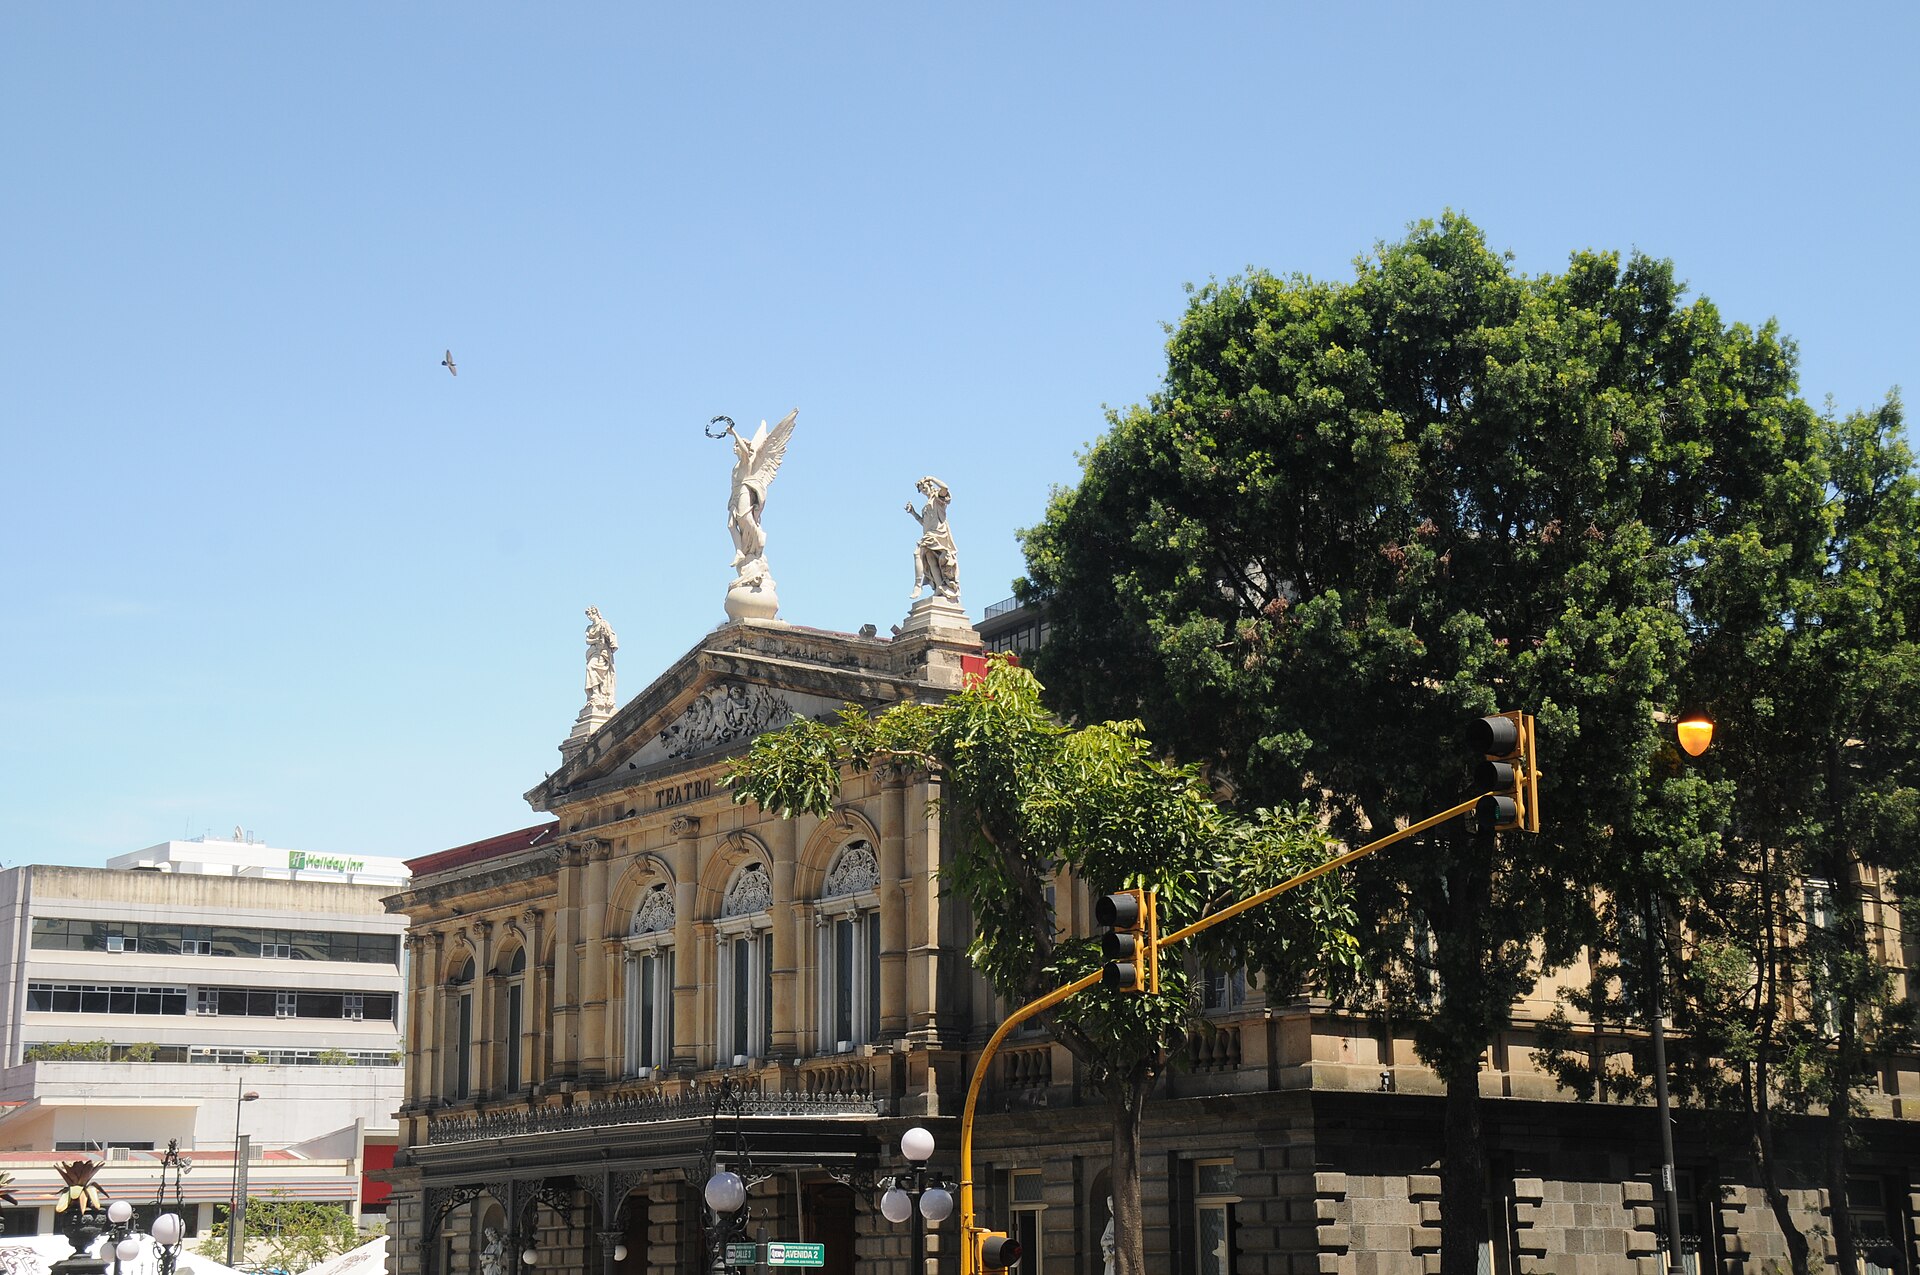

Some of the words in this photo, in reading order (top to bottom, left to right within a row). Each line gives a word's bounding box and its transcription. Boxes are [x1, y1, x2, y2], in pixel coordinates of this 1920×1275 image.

[656, 778, 710, 808] TEATRO
[306, 854, 346, 872] Holiday
[347, 857, 364, 872] Inn
[736, 1250, 747, 1259] CALLE
[786, 1250, 813, 1259] AVENIDA
[814, 1251, 819, 1259] 2
